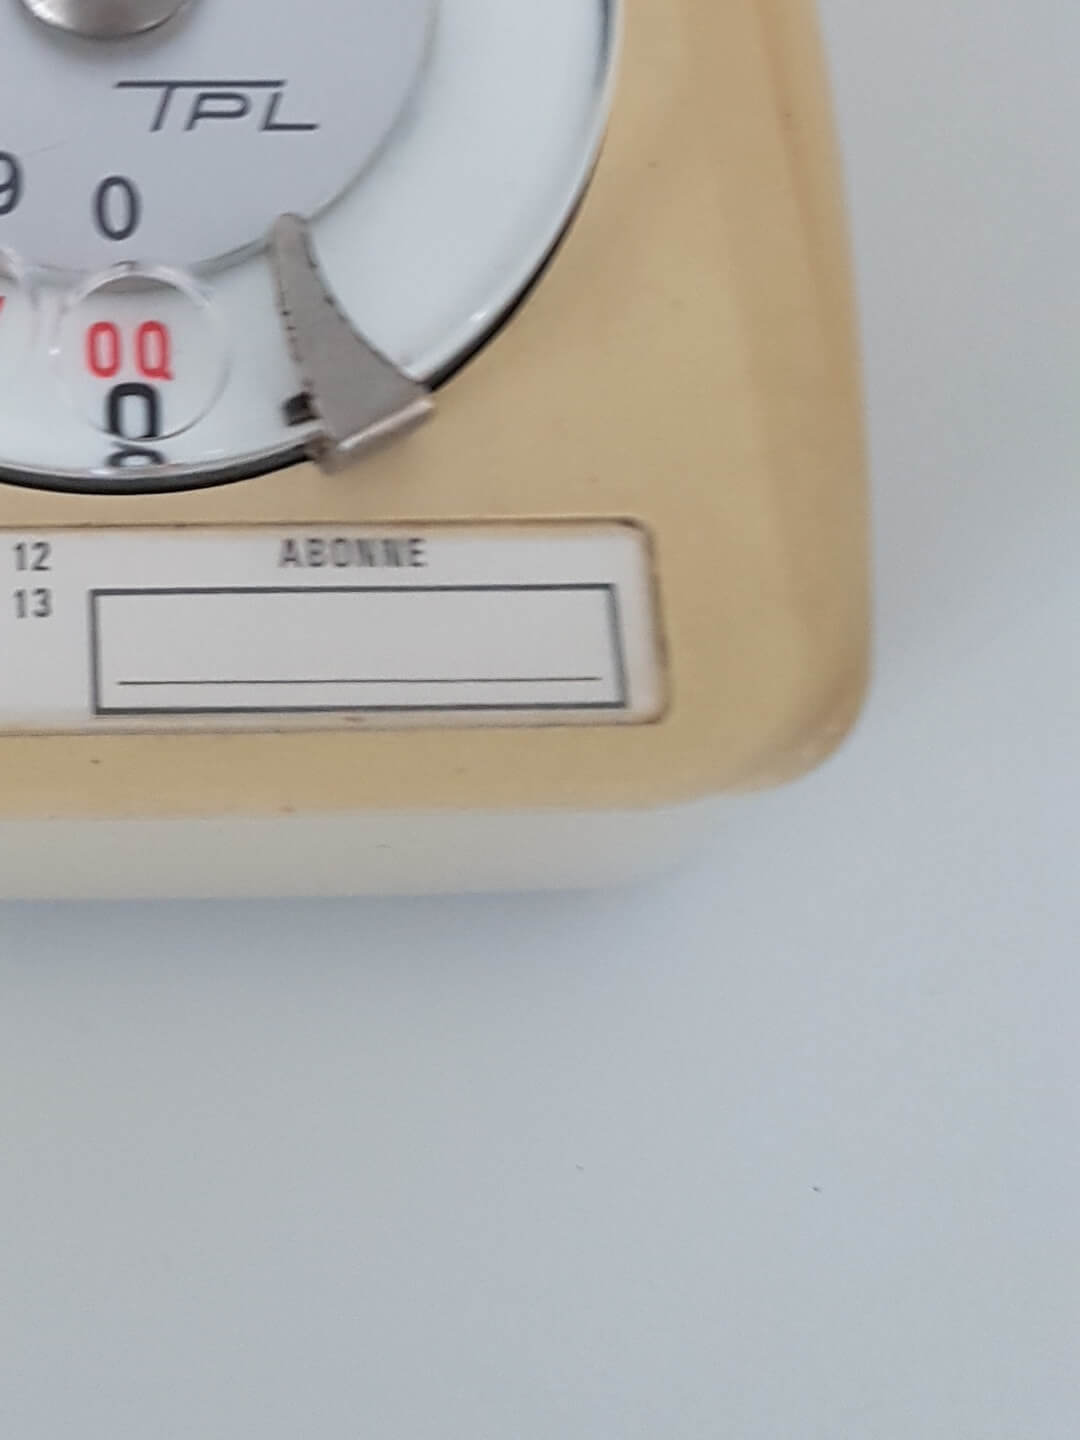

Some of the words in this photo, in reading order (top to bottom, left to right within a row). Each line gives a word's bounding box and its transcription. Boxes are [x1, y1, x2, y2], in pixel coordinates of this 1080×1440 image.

[114, 80, 319, 132] TPL
[86, 321, 174, 380] OQ
[11, 540, 52, 573] 12
[277, 537, 428, 569] ABONNE
[12, 588, 52, 620] 13
